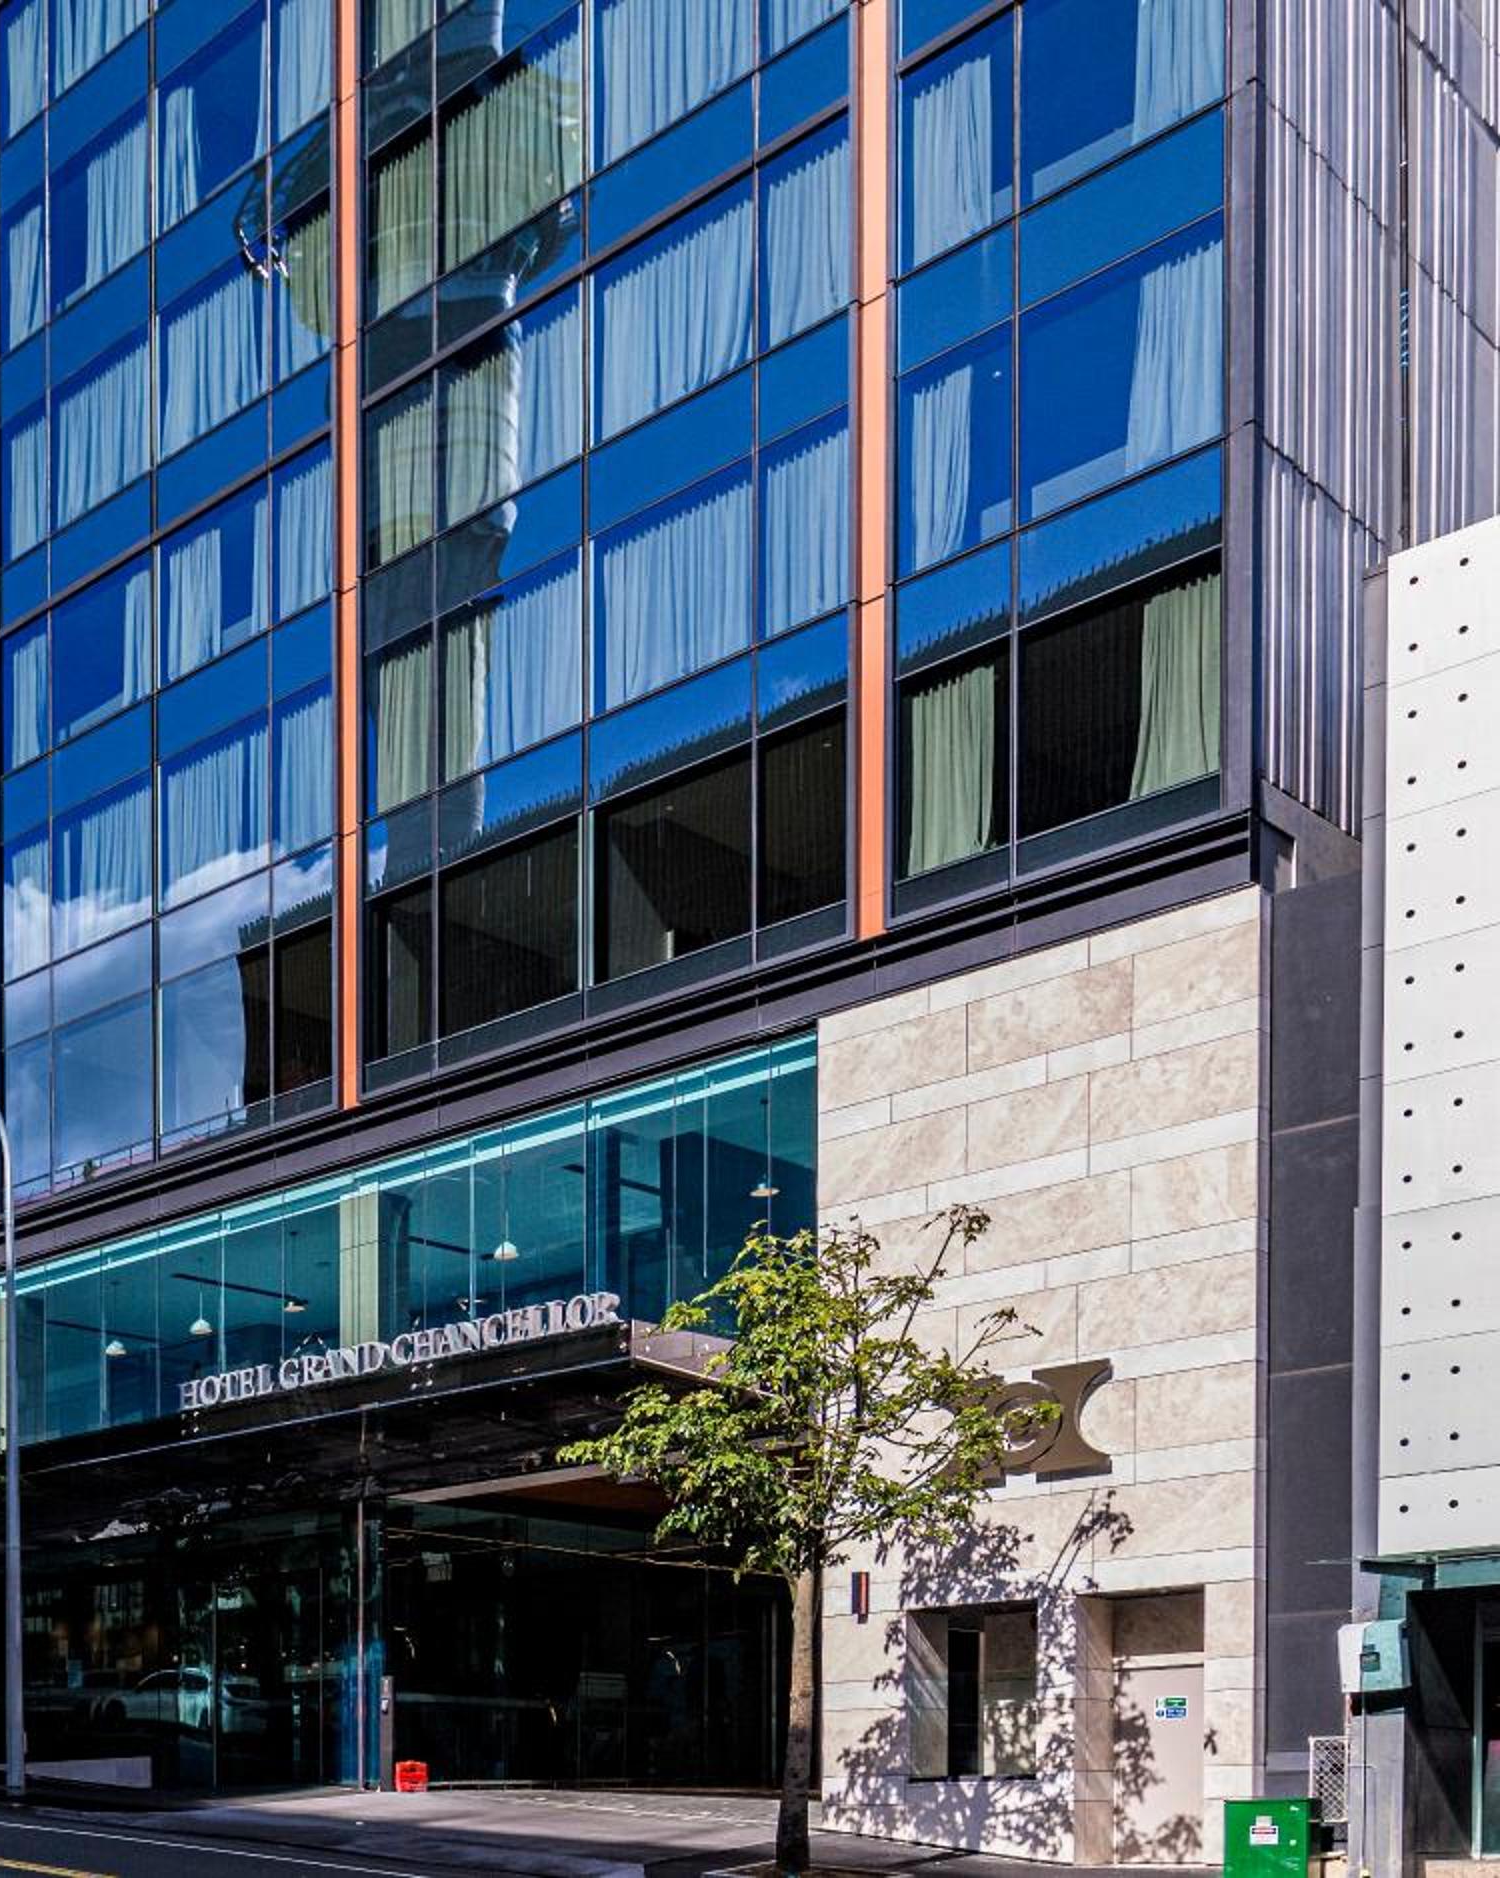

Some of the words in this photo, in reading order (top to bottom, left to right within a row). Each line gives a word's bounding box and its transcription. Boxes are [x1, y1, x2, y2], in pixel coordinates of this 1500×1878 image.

[179, 1363, 275, 1410] HOTEL
[278, 1342, 390, 1391] GRAND
[391, 1291, 621, 1366] CHANCELLOR
